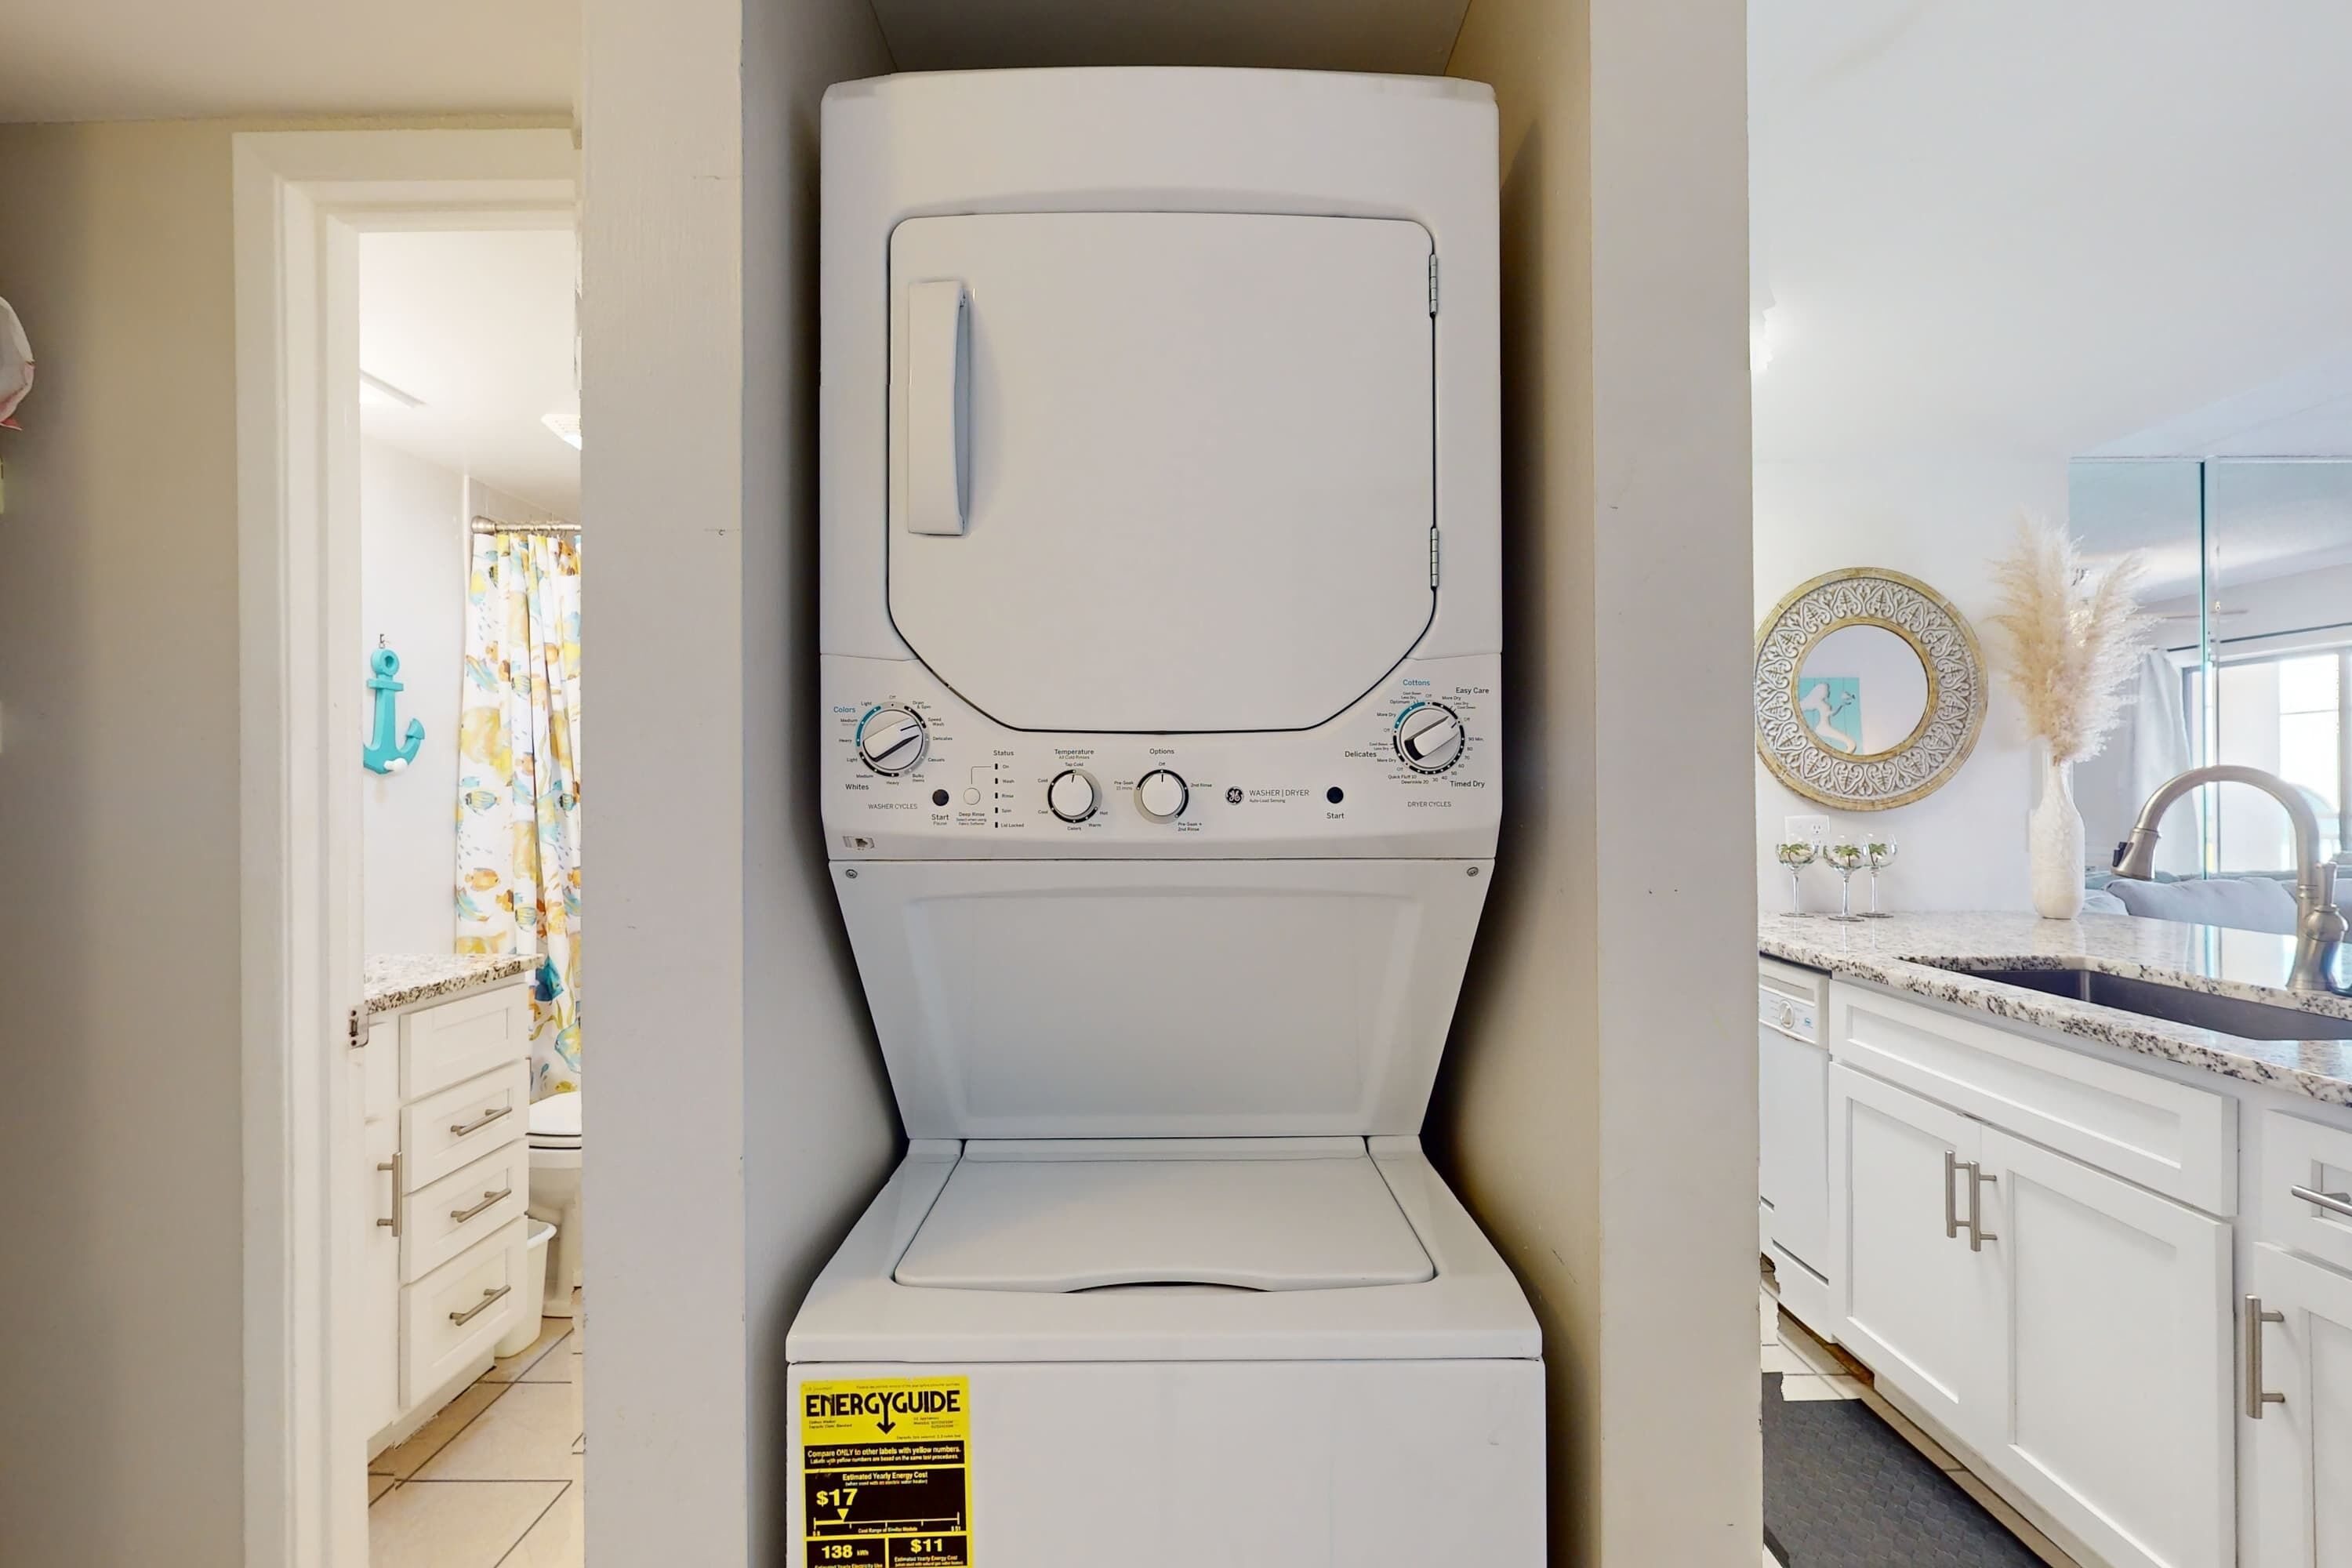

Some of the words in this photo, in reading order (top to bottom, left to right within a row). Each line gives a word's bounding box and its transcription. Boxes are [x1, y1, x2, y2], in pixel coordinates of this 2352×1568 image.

[1456, 687, 1472, 695] Easy
[1472, 780, 1486, 789] Dry
[805, 1390, 960, 1417] ENERGYGUIDE
[862, 1447, 879, 1456] other
[912, 1446, 932, 1456] yellow
[932, 1445, 961, 1454] numbers.
[842, 1472, 872, 1481] Estimated
[872, 1472, 891, 1481] Yearly
[891, 1472, 913, 1480] Energy
[816, 1488, 858, 1508] $17
[821, 1544, 853, 1559] 138
[910, 1538, 943, 1554] $11
